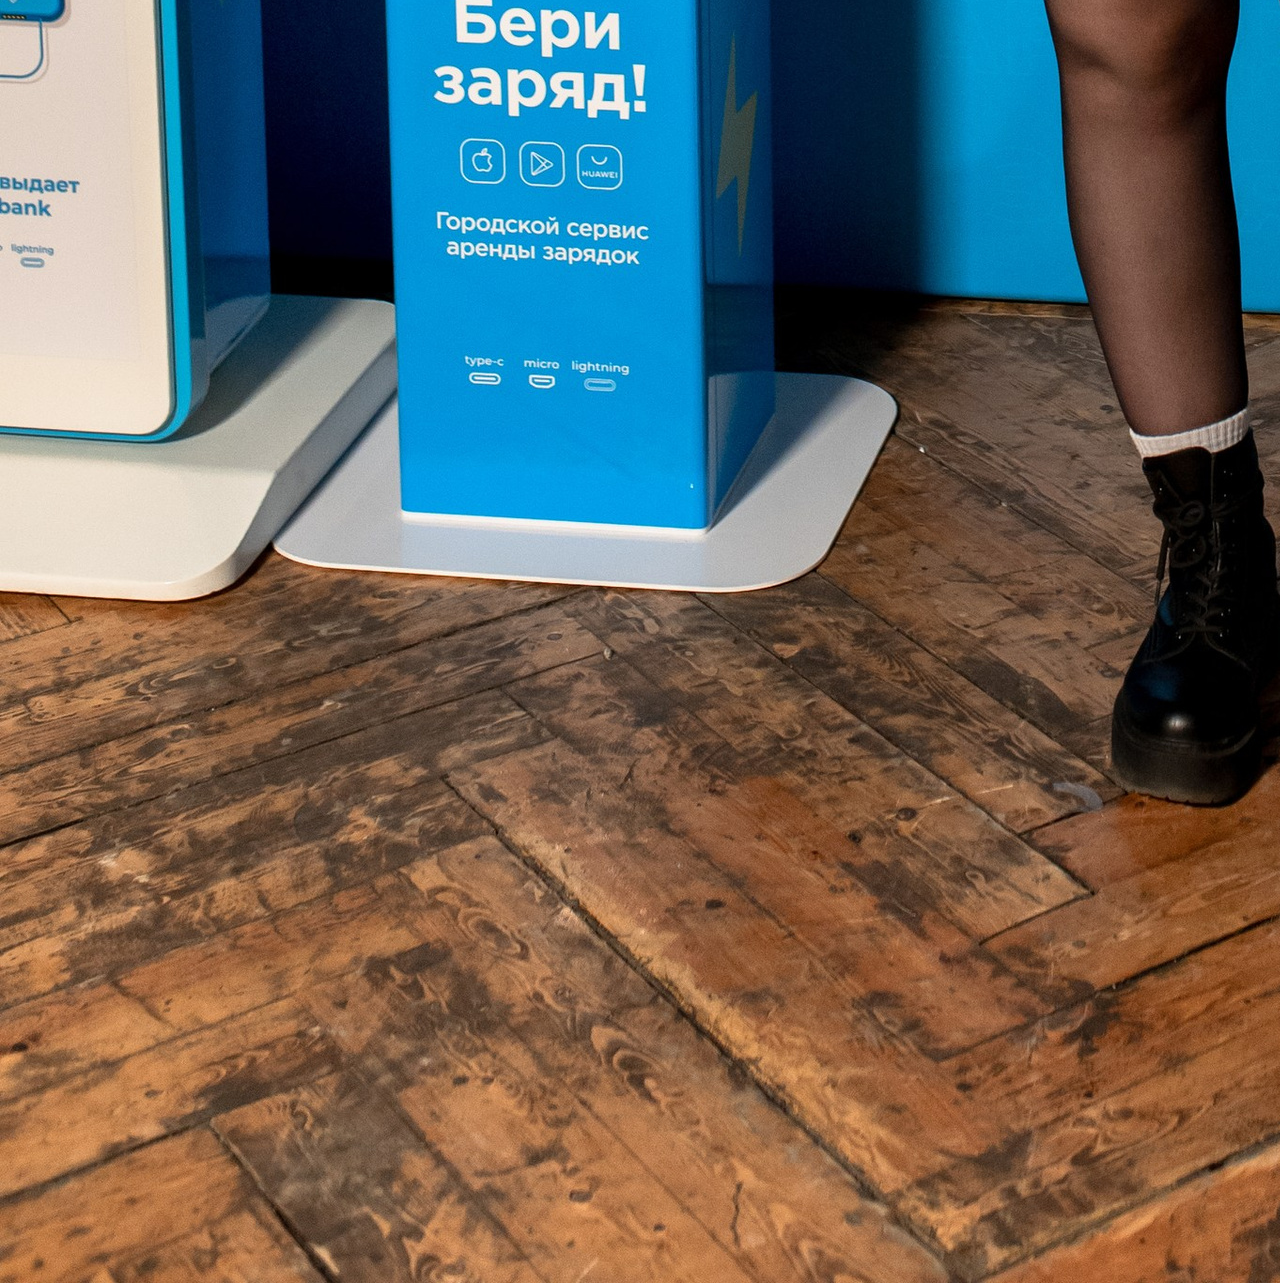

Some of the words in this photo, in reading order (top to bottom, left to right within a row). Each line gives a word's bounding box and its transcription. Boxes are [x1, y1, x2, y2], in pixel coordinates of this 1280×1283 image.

[434, 64, 646, 119] заряд!
[581, 169, 619, 179] HUAWEI
[0, 177, 80, 194] выдает
[437, 211, 559, 237] Городской
[566, 222, 649, 241] сервис
[11, 243, 54, 257] lightning
[446, 241, 536, 261] аренды
[543, 246, 640, 266] зарядок
[465, 355, 504, 368] type-c
[524, 358, 560, 369] micro
[571, 360, 630, 376] lightning
